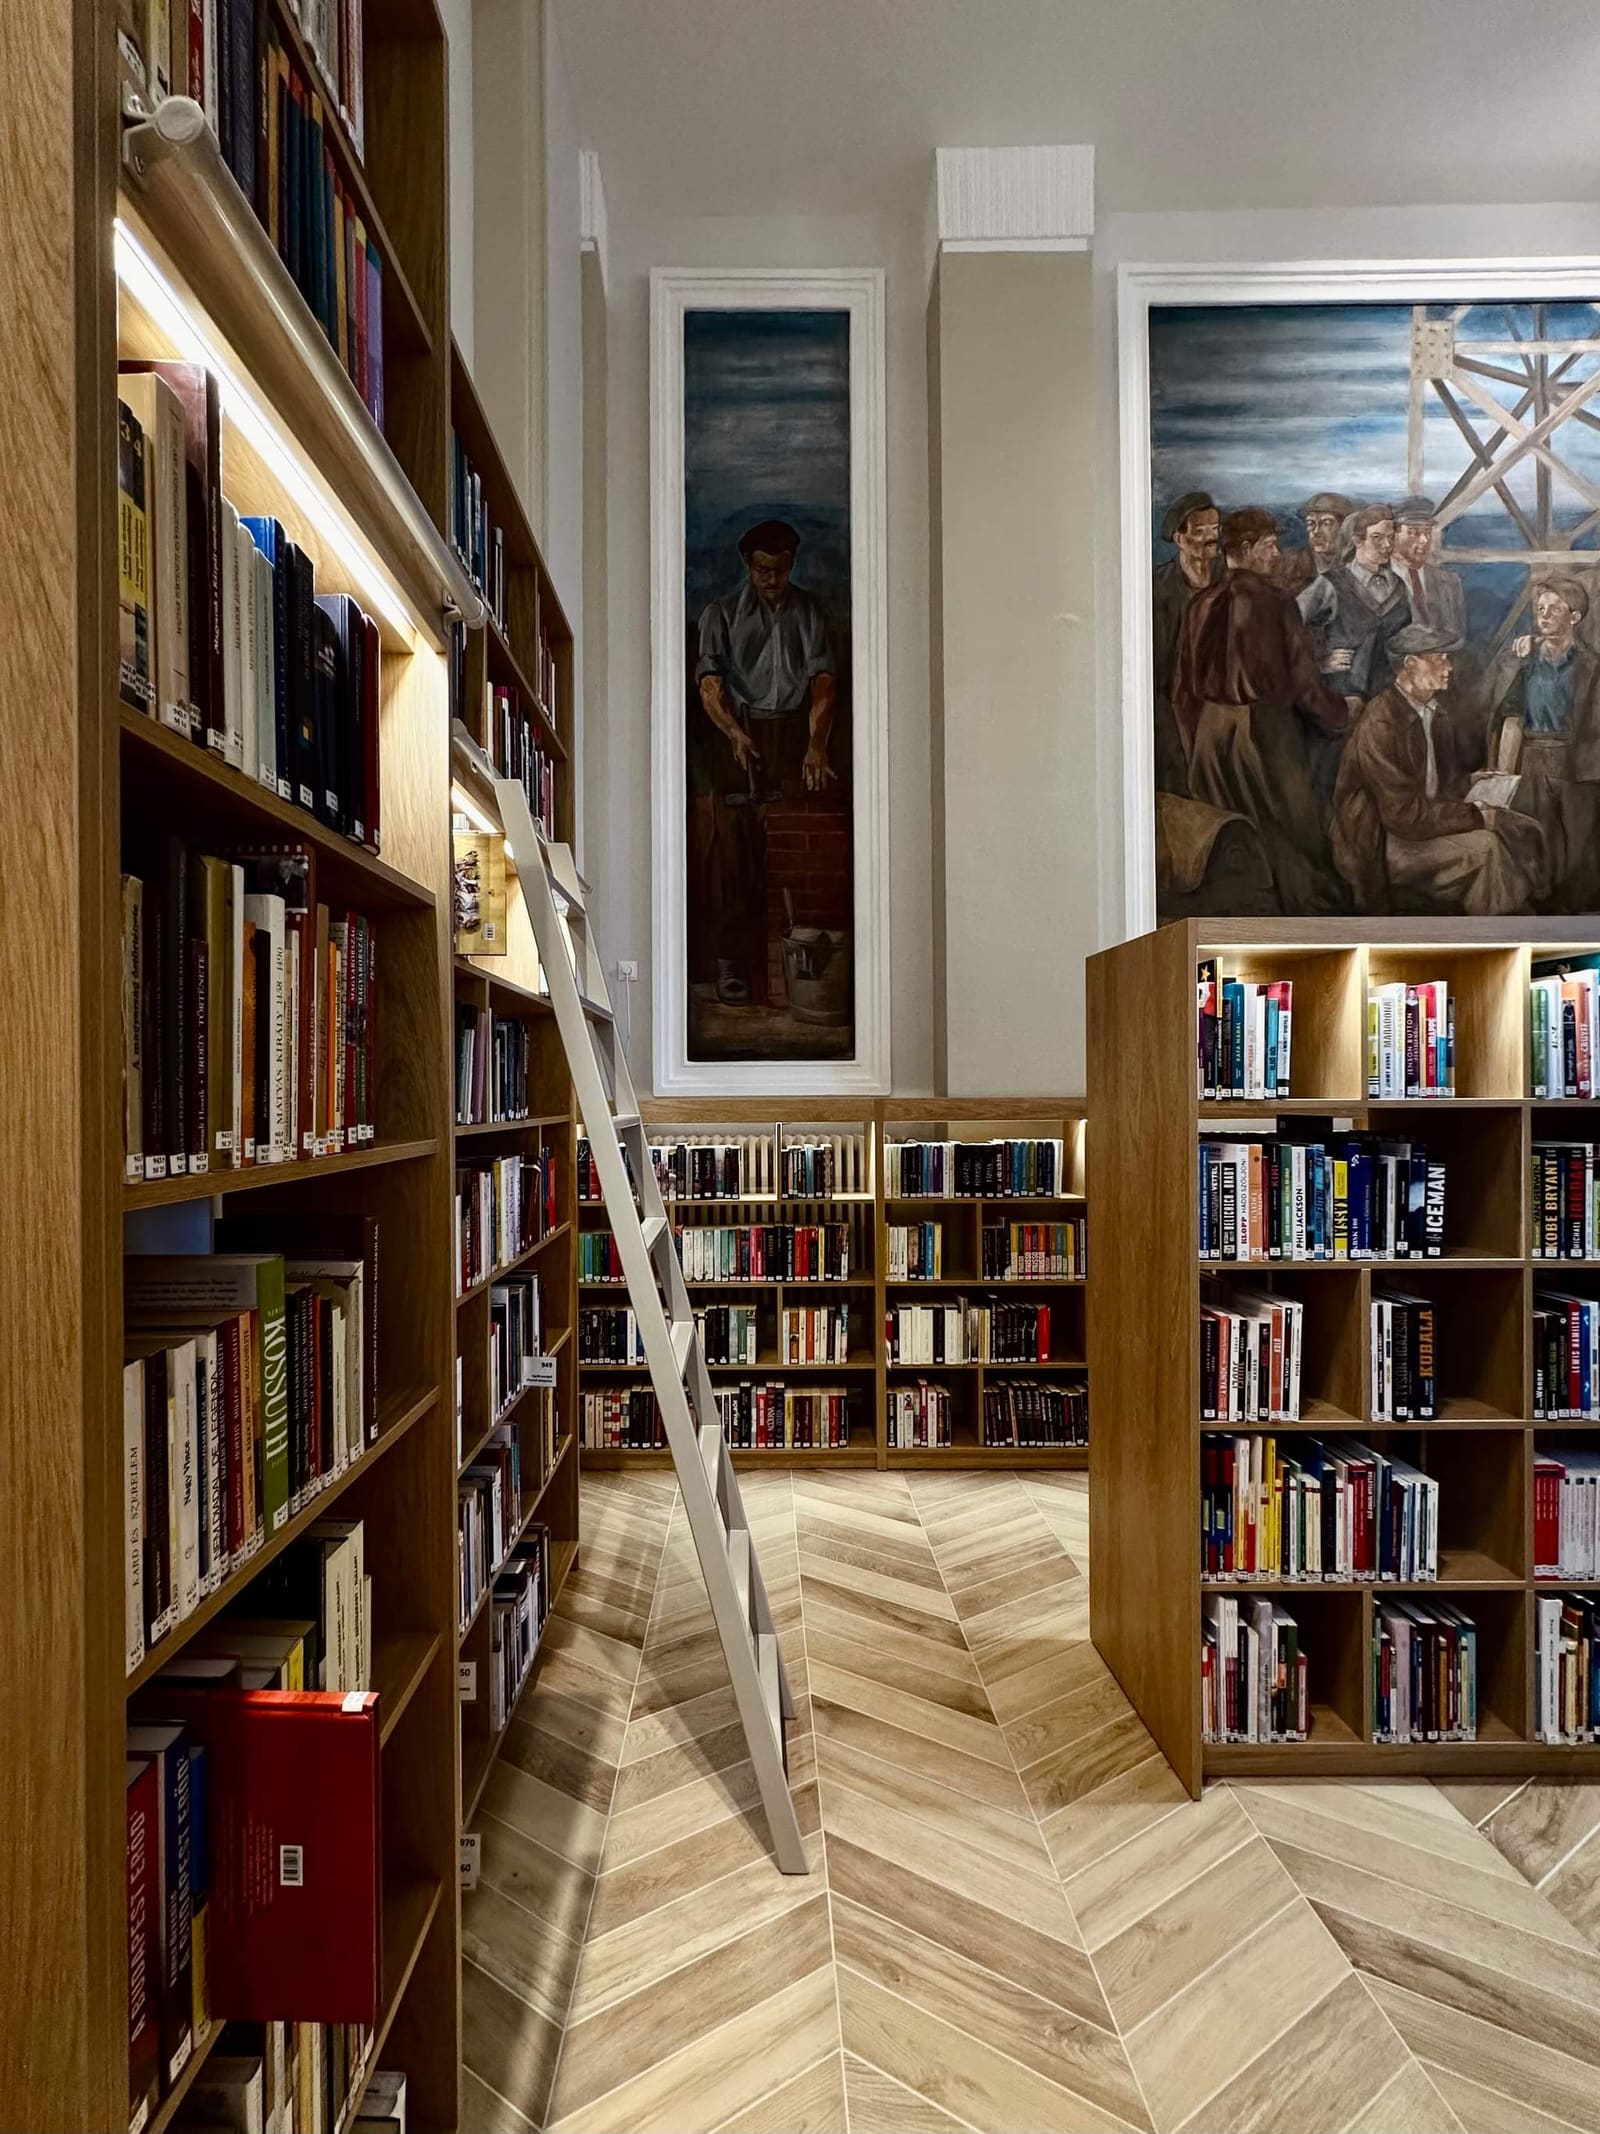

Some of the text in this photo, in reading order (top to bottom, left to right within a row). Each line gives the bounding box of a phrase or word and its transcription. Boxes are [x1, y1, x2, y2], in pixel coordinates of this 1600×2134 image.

[357, 929, 365, 1006] MAGYARORSZÁG
[196, 1033, 206, 1075] ERDÉLY
[274, 1011, 284, 1062] KIRÁLY
[1383, 1001, 1393, 1048] MARADONA
[274, 1069, 284, 1124] MÁTYÁS
[1210, 1166, 1218, 1191] VETTEL
[1426, 1166, 1446, 1233] ICEMAN
[1545, 1159, 1558, 1249] KOBE BRYANT
[1569, 1160, 1584, 1249] MICHAEL JORDAN
[1296, 1188, 1304, 1249] PHIL JACKSON
[1419, 1309, 1433, 1377] KUBALA
[1571, 1311, 1580, 1374] LEWIS HAMILTON
[264, 1315, 287, 1462] KOSSUTH
[1536, 1368, 1544, 1399] Wenger
[129, 1446, 140, 1586] KARD ÉS SZERELEM
[182, 1475, 193, 1506] Nagy
[130, 1882, 146, 2021] BUDAPEST
